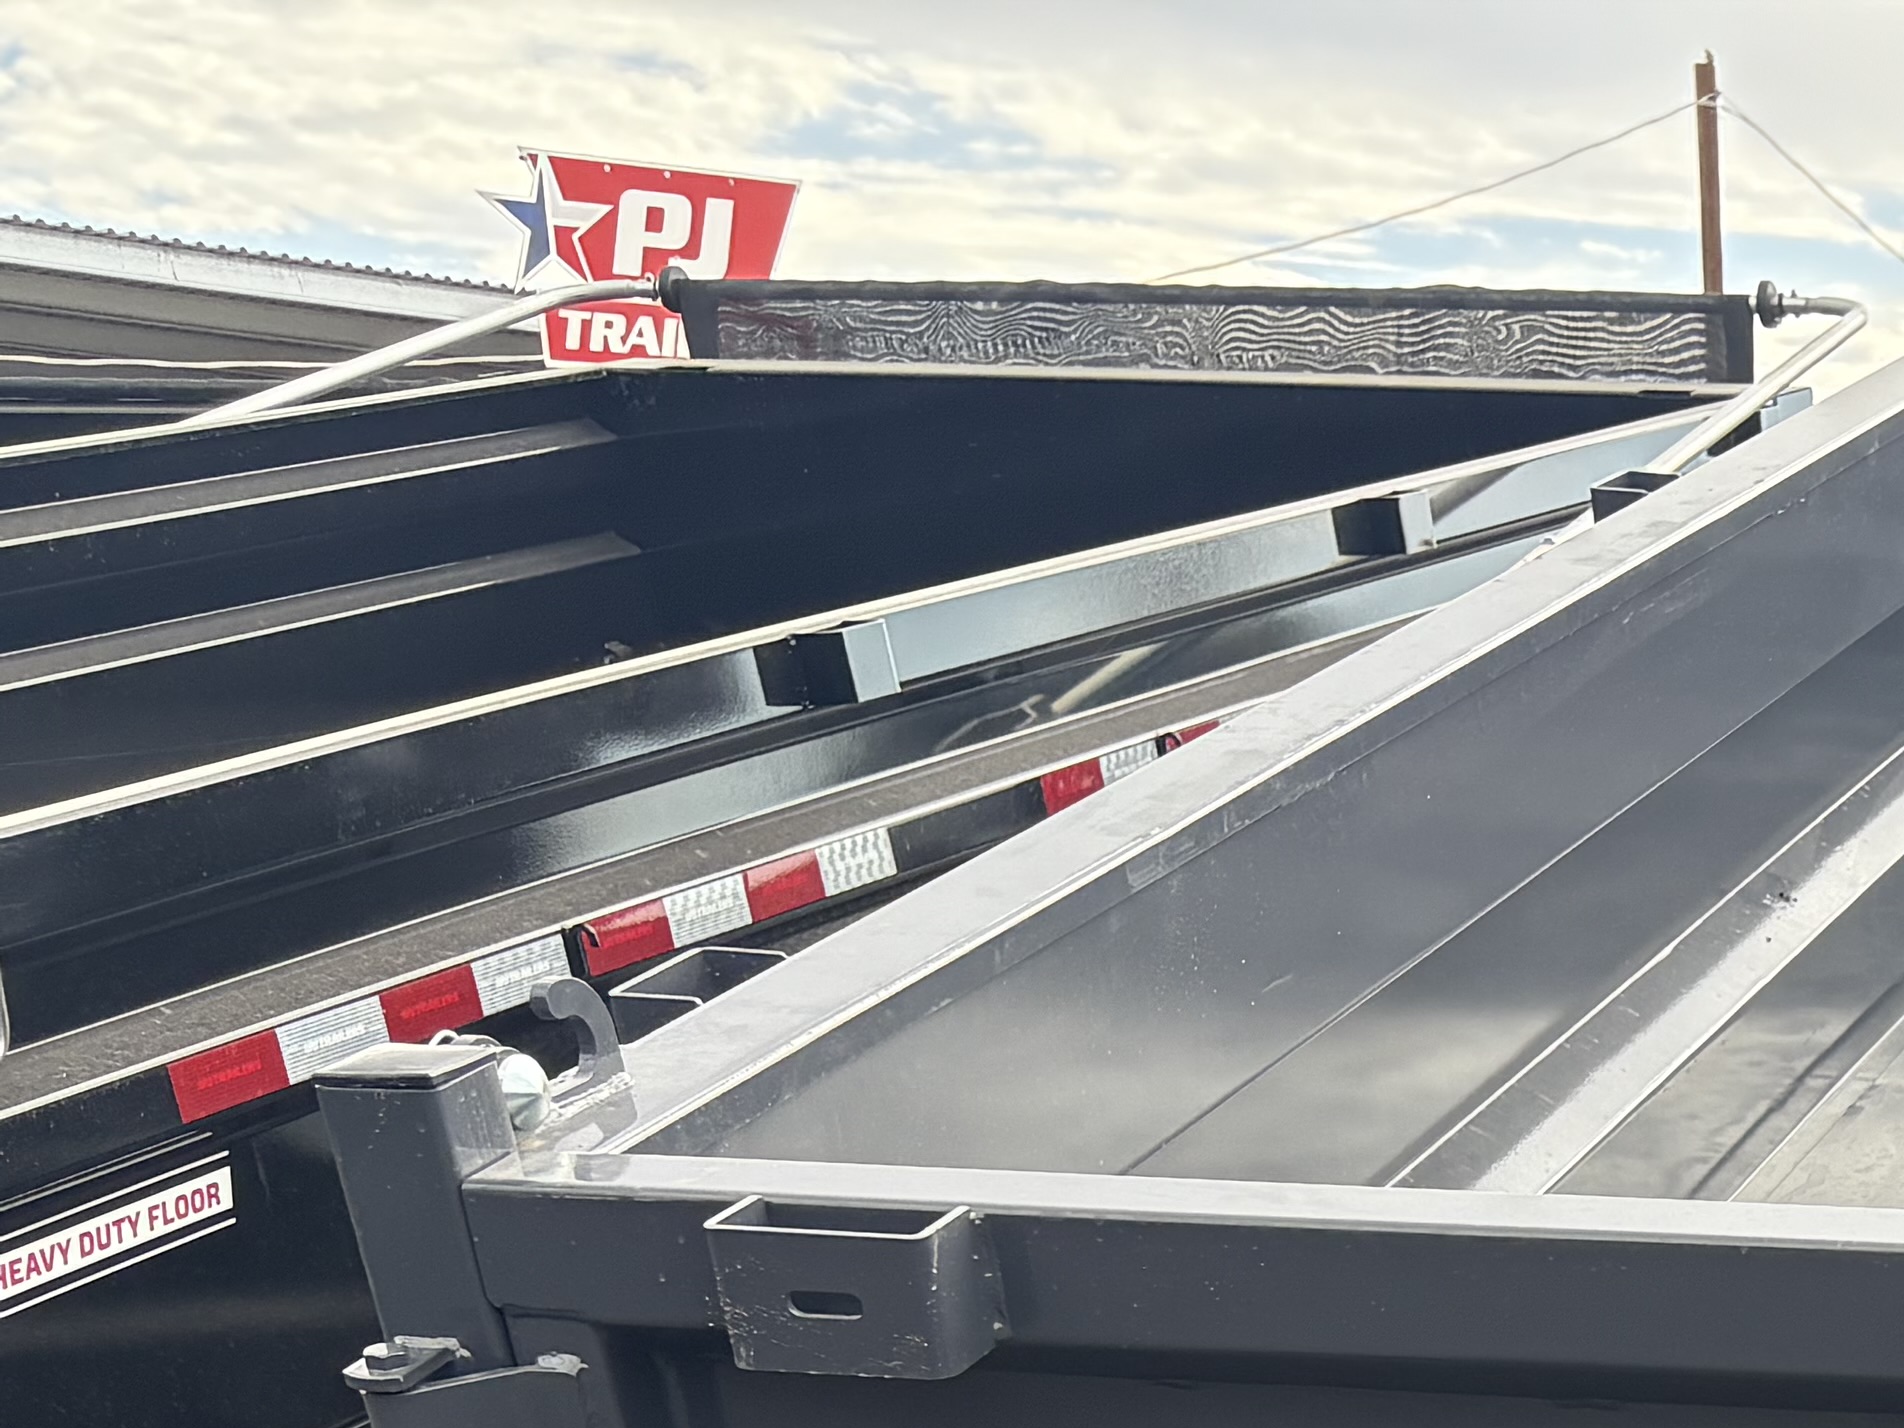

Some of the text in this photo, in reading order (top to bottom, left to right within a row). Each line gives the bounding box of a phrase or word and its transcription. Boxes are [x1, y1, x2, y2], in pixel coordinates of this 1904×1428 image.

[612, 188, 735, 280] PJ
[79, 1211, 141, 1259] DUTY
[148, 1181, 221, 1232] FLOOR
